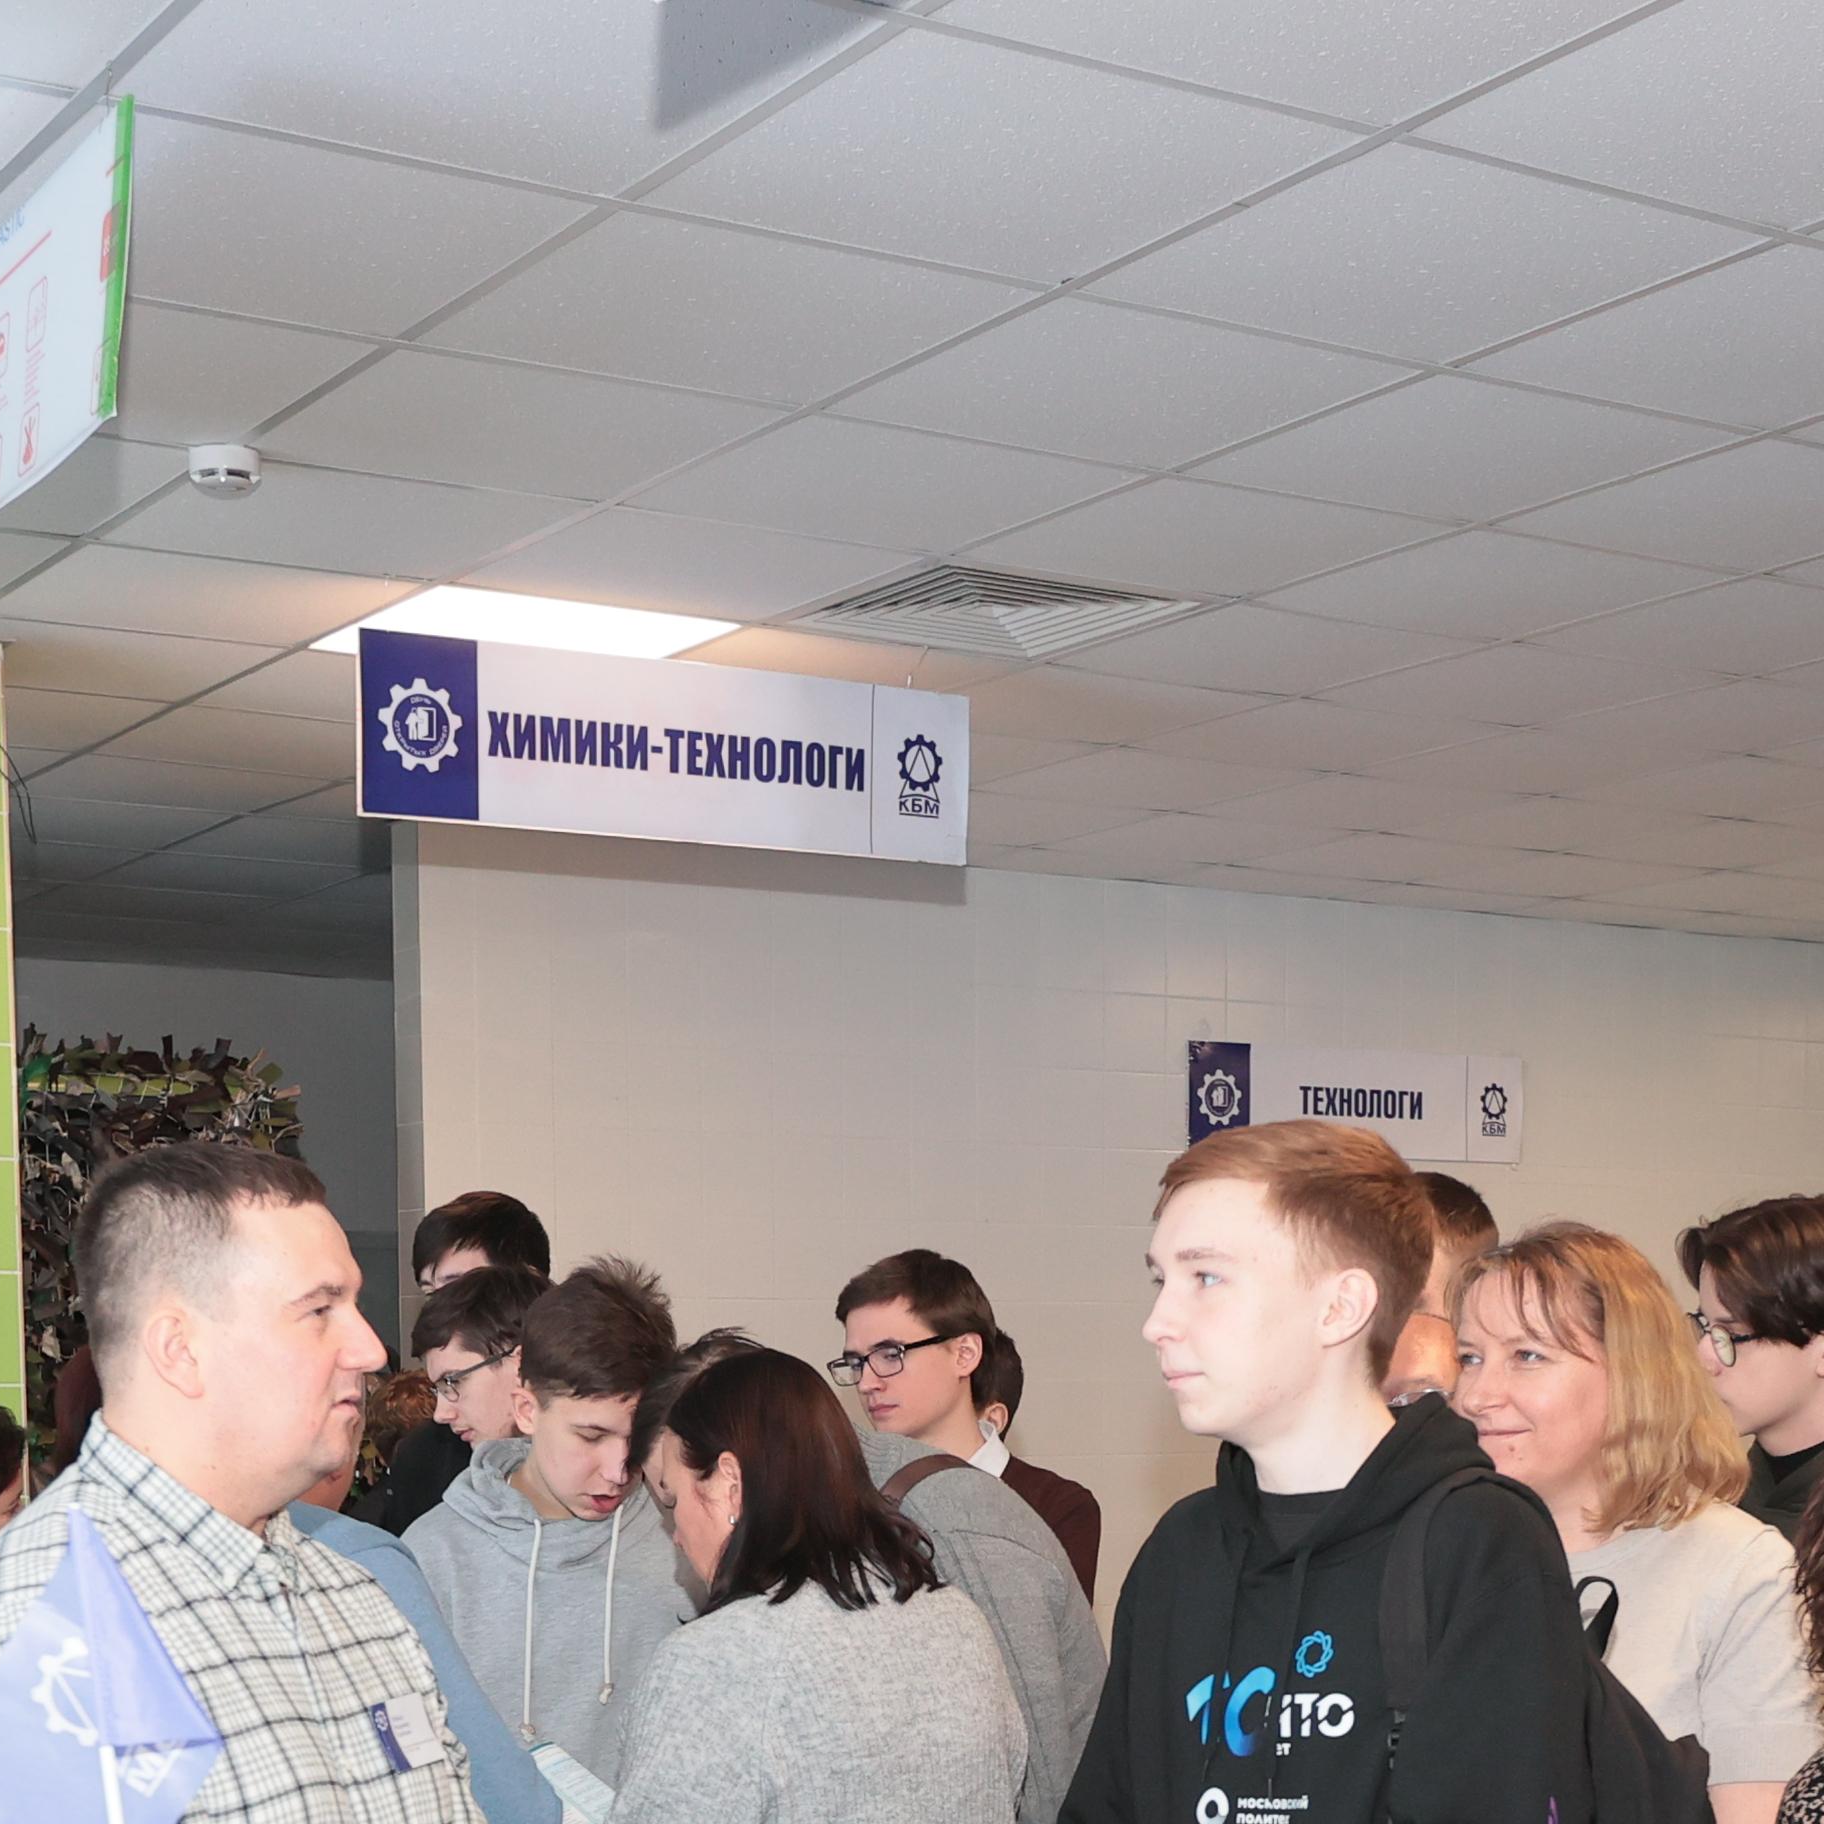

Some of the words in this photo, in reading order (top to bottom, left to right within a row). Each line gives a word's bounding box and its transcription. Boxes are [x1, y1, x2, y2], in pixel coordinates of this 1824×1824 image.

[488, 710, 866, 793] ХИМИКИ-ТЕХНОЛОГИ
[899, 797, 940, 815] КБМ
[1299, 1084, 1424, 1121] ТЕХНОЛОГИ
[1481, 1124, 1507, 1136] КБМ
